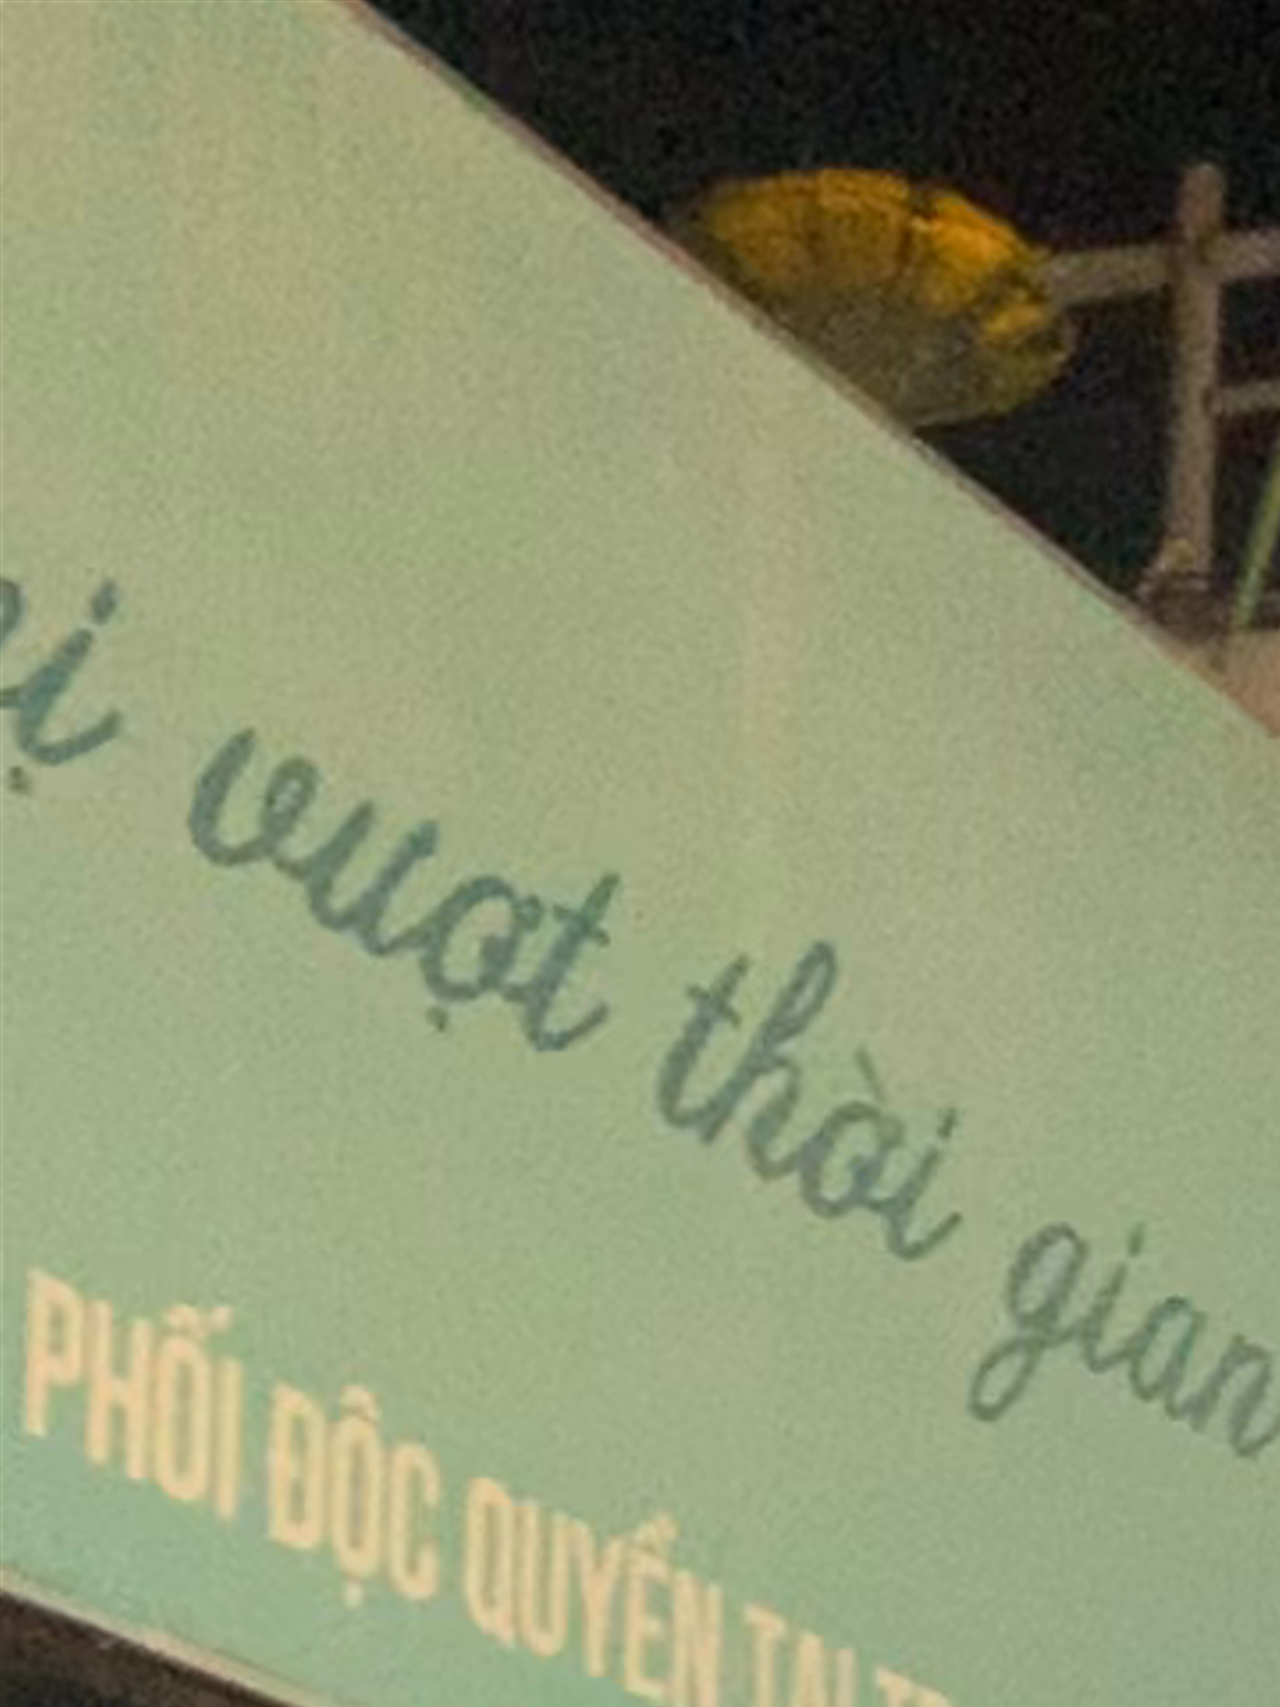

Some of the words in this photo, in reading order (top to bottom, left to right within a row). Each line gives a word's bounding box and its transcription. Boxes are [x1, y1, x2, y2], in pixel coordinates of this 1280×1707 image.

[0, 578, 123, 794] ị
[187, 726, 620, 1052] vượt
[656, 941, 964, 1261] thời
[23, 1266, 243, 1523] PHỐI
[268, 1380, 443, 1610] ĐỘC
